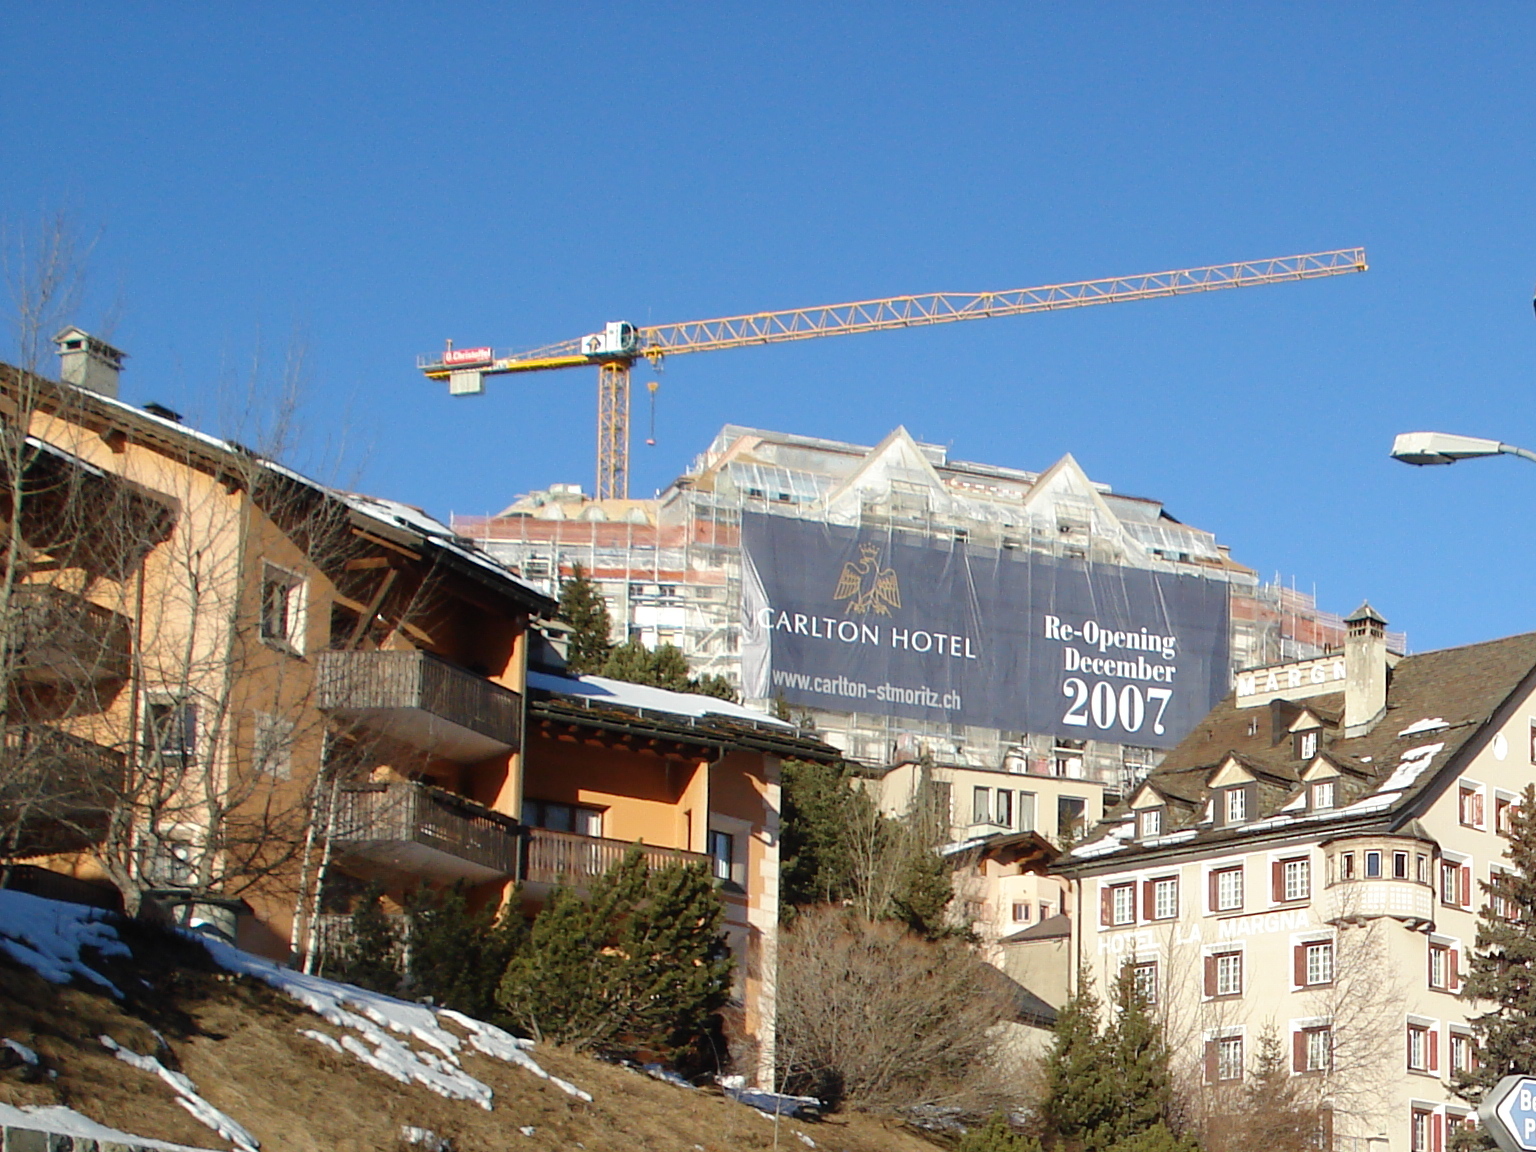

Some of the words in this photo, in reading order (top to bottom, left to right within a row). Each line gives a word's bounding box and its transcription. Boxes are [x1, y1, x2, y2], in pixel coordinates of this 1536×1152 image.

[758, 607, 879, 645] CARLTON
[892, 627, 976, 659] HOTEL
[1044, 615, 1176, 660] Re-Opening
[1064, 647, 1177, 682] December
[772, 668, 961, 710] www.carlton-stmoritz.ch
[1062, 677, 1173, 735] 2007
